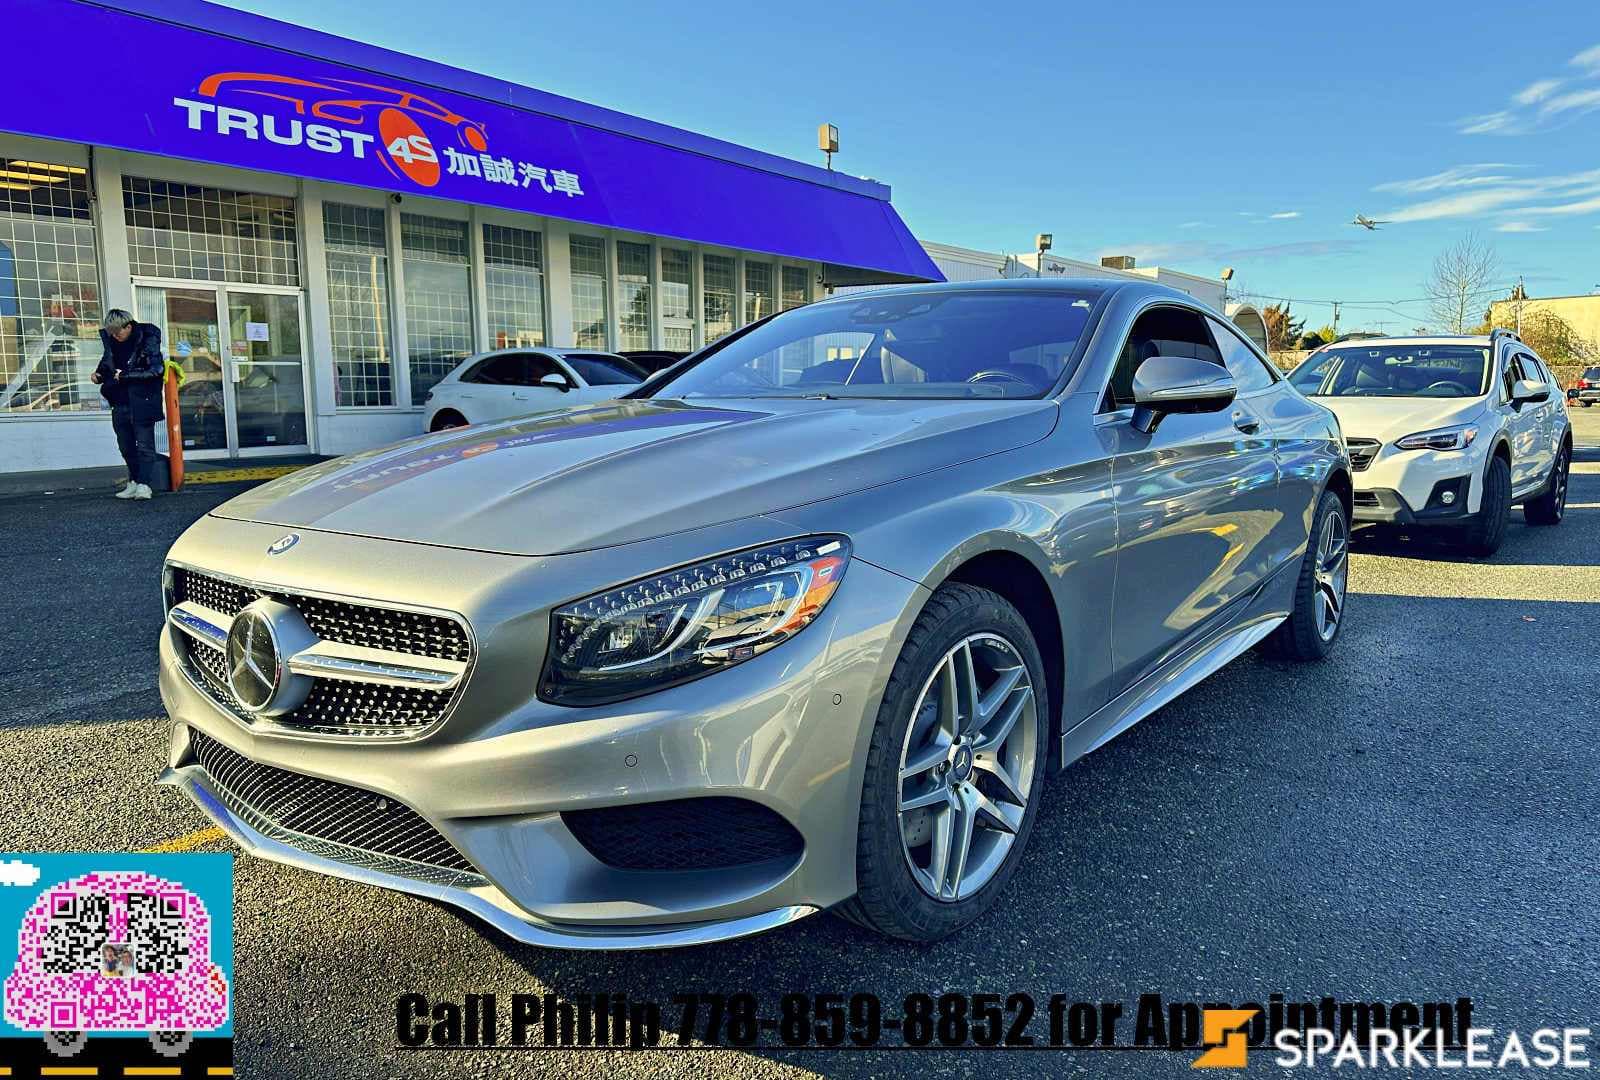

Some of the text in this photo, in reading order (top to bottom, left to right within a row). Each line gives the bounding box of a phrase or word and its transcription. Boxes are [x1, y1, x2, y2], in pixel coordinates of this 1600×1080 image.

[173, 96, 438, 164] TRUST 4S
[443, 146, 585, 198] 加誠汽車
